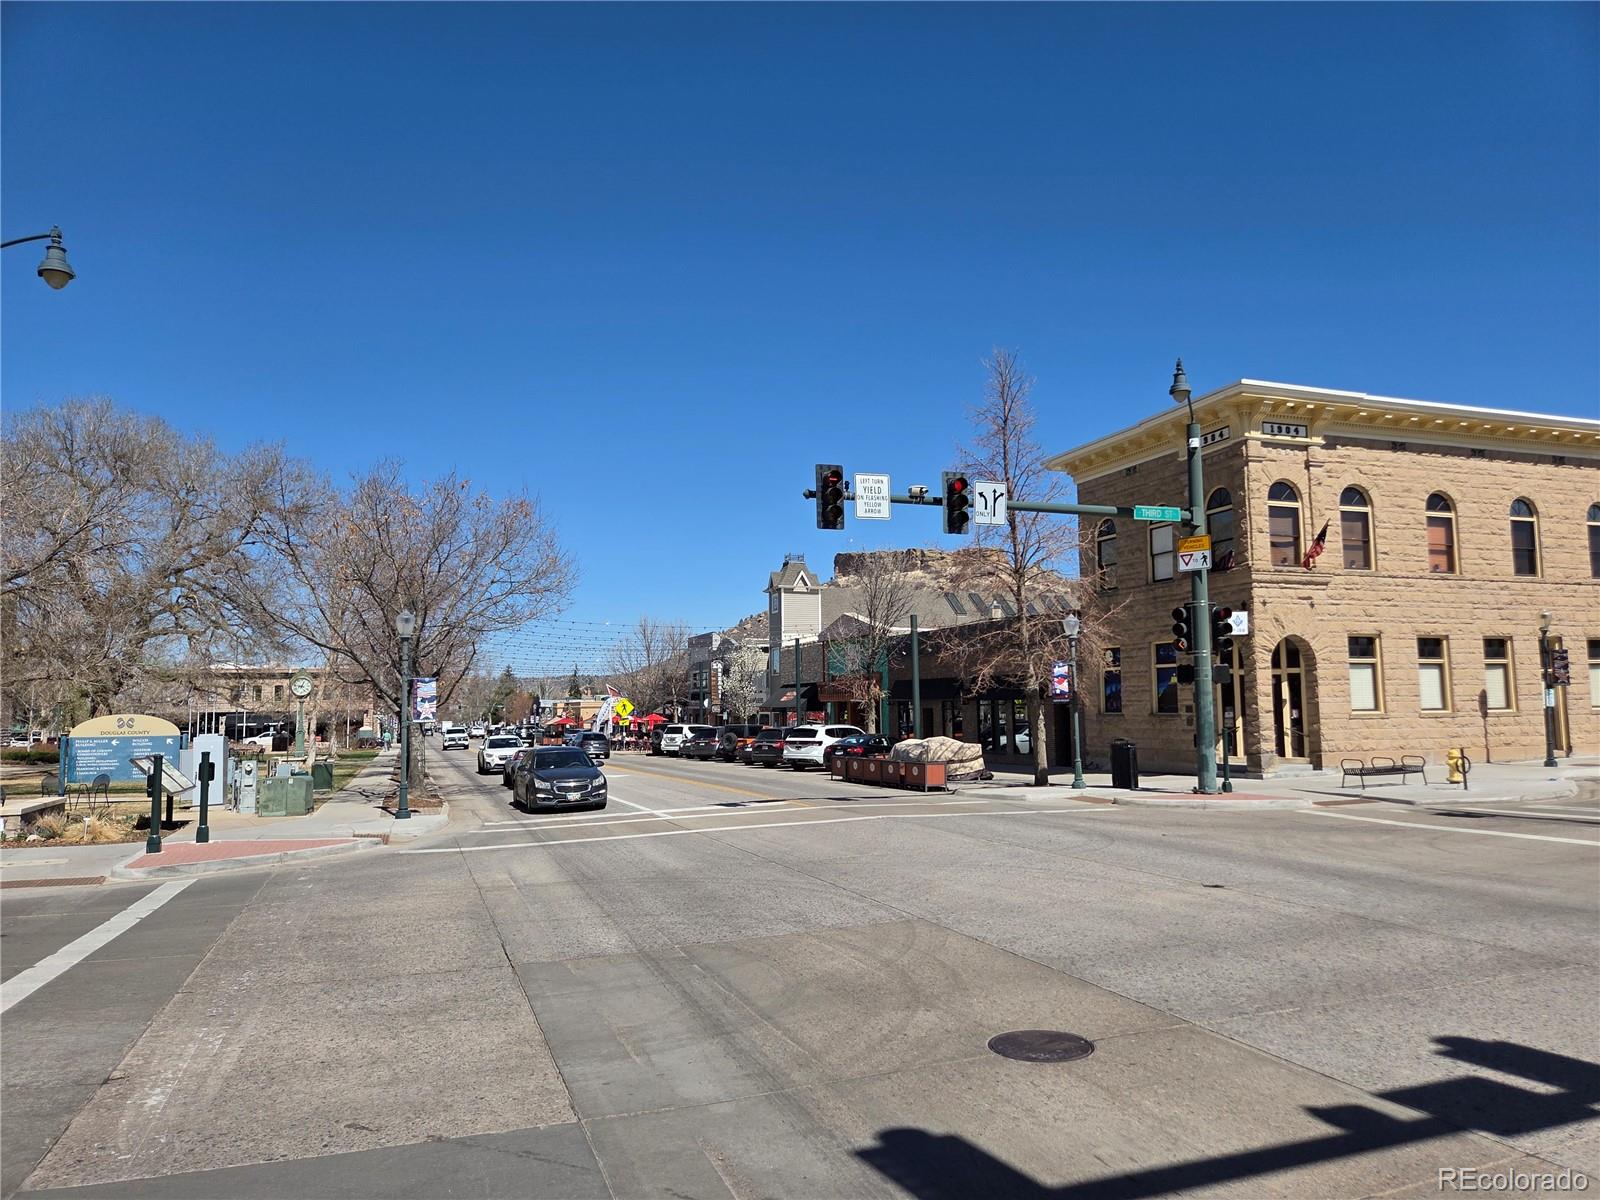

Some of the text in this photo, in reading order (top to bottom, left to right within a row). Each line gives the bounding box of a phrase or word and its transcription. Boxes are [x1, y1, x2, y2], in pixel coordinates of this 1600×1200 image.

[1270, 425, 1300, 435] 1904
[863, 486, 882, 494] YIELD
[1141, 508, 1174, 518] THIRD ST
